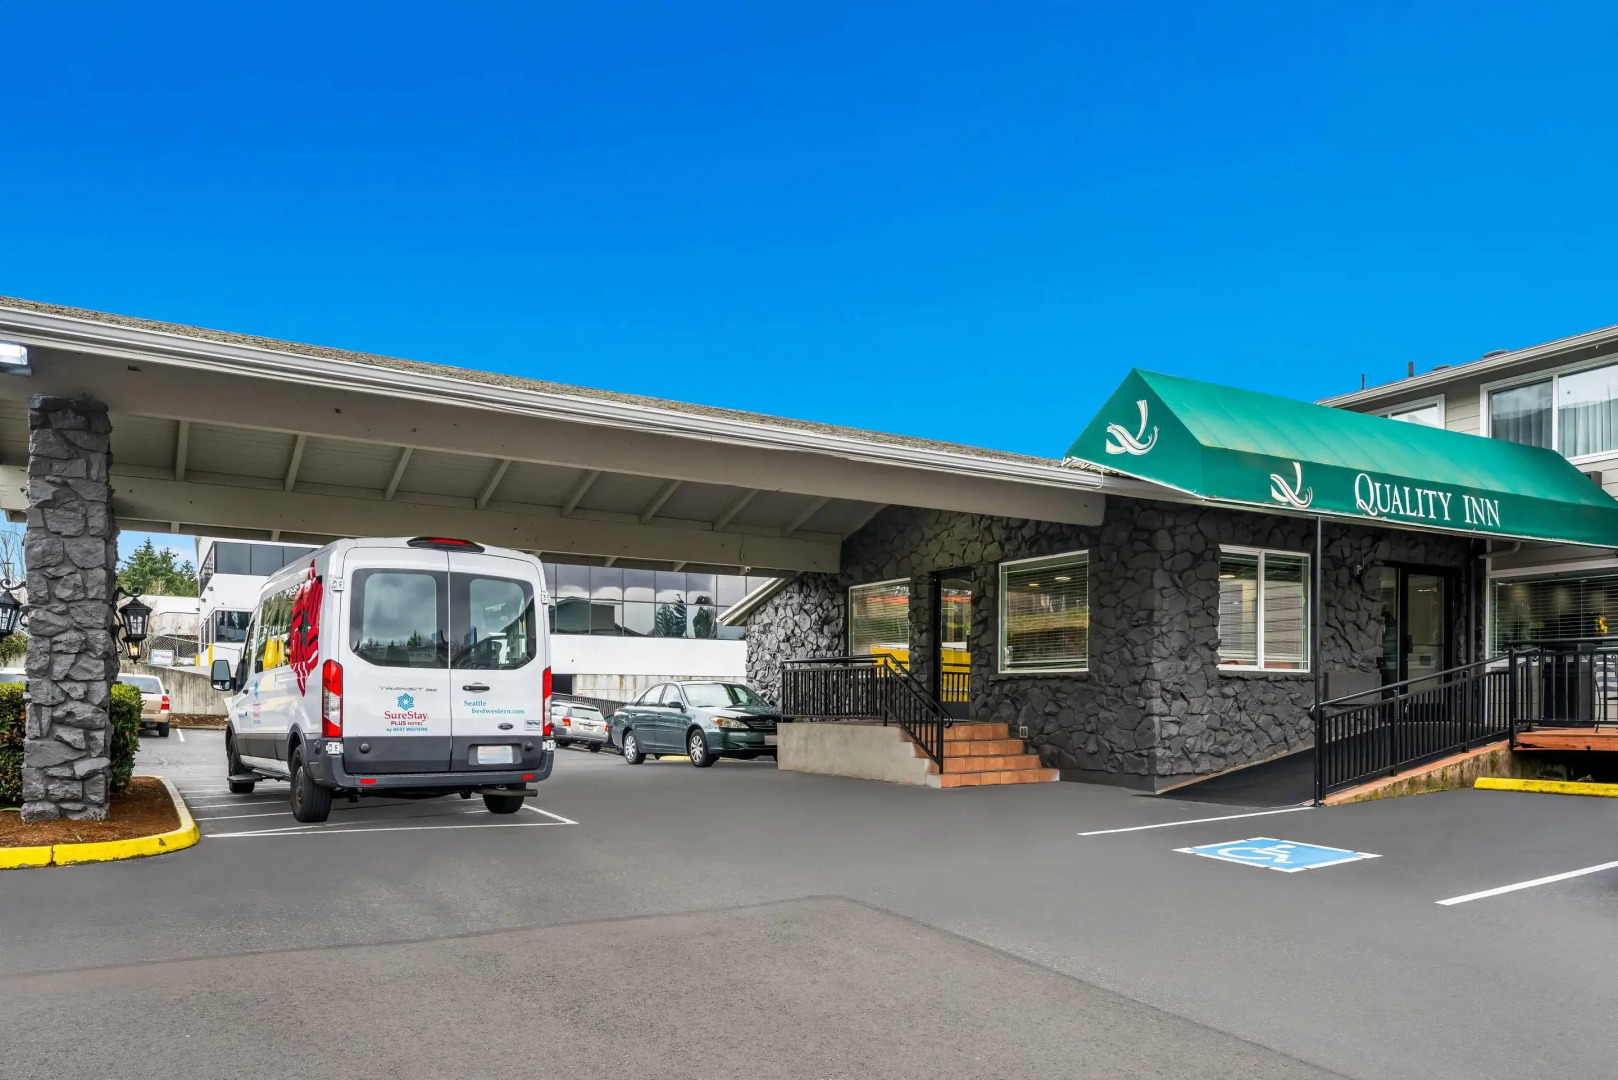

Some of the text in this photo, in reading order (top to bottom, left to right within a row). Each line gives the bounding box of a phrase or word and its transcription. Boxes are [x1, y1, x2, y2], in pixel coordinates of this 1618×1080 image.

[1354, 472, 1500, 528] QUALITY INN
[384, 710, 428, 722] SureStay
